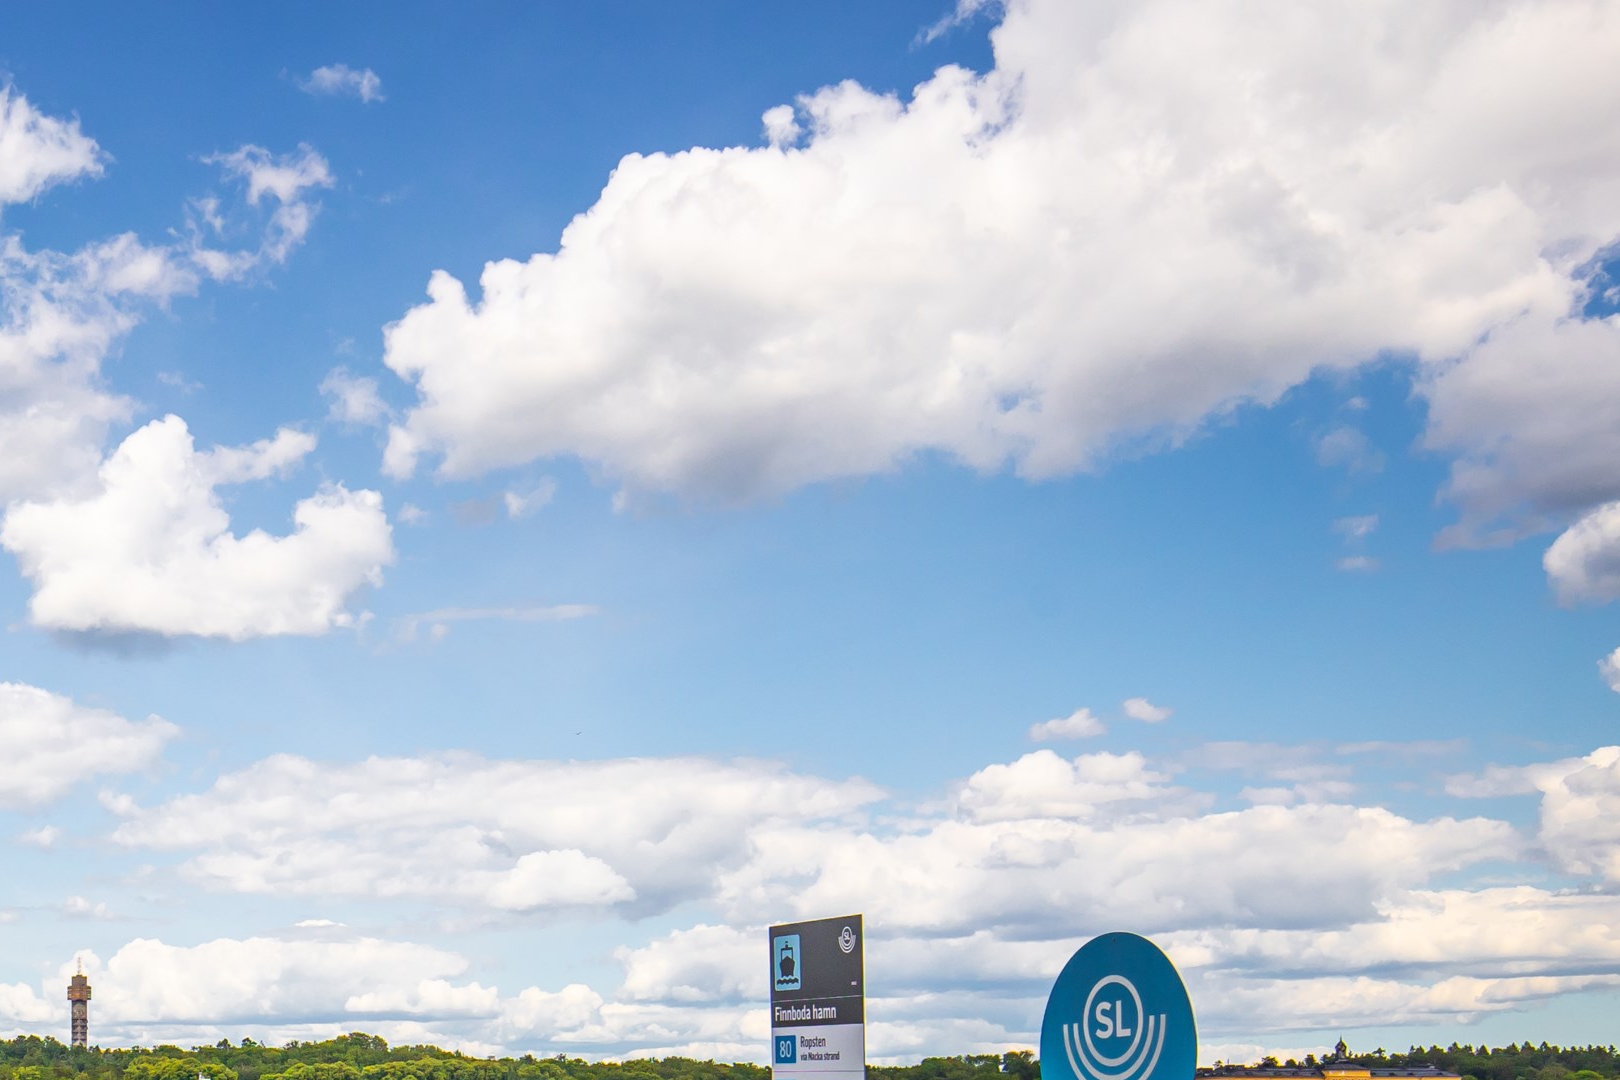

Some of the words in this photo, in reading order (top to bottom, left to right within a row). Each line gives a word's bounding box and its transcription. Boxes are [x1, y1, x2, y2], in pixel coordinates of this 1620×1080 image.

[775, 1004, 811, 1021] Finnboda
[812, 1004, 837, 1020] hamn
[1095, 999, 1132, 1040] SL
[779, 1040, 792, 1058] 80
[800, 1036, 826, 1050] Ropsten
[800, 1053, 808, 1061] via
[823, 1051, 840, 1061] strand
